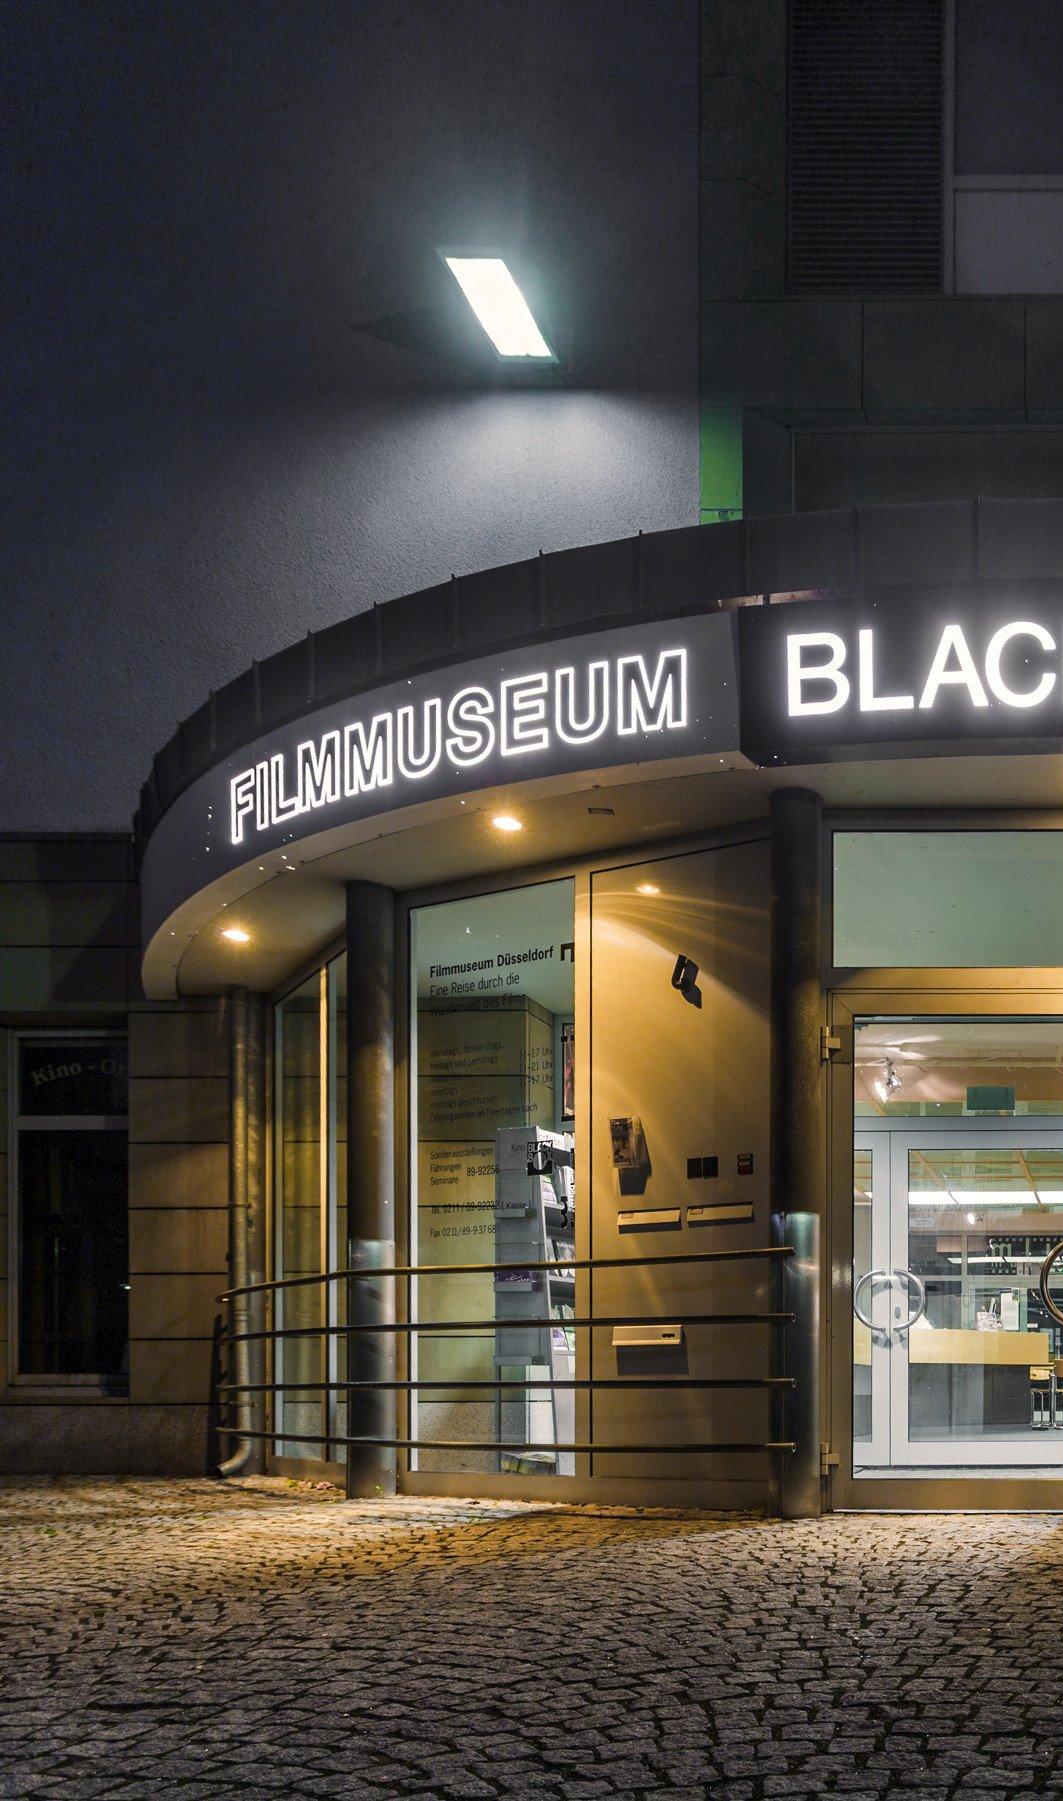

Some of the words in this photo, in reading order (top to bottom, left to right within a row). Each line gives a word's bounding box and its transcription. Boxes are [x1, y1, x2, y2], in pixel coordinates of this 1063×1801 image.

[230, 648, 689, 846] FILMMUSEUM
[430, 958, 494, 978] Filmmuseum
[497, 945, 554, 967] Düsseldorf
[430, 985, 449, 998] Eine
[451, 980, 476, 995] Reise
[478, 974, 504, 990] durch
[506, 972, 520, 986] die
[503, 993, 528, 1006] Films
[430, 1147, 494, 1160] Sonderausstellungen
[430, 1163, 462, 1173] Führungen
[430, 1228, 441, 1238] Fax
